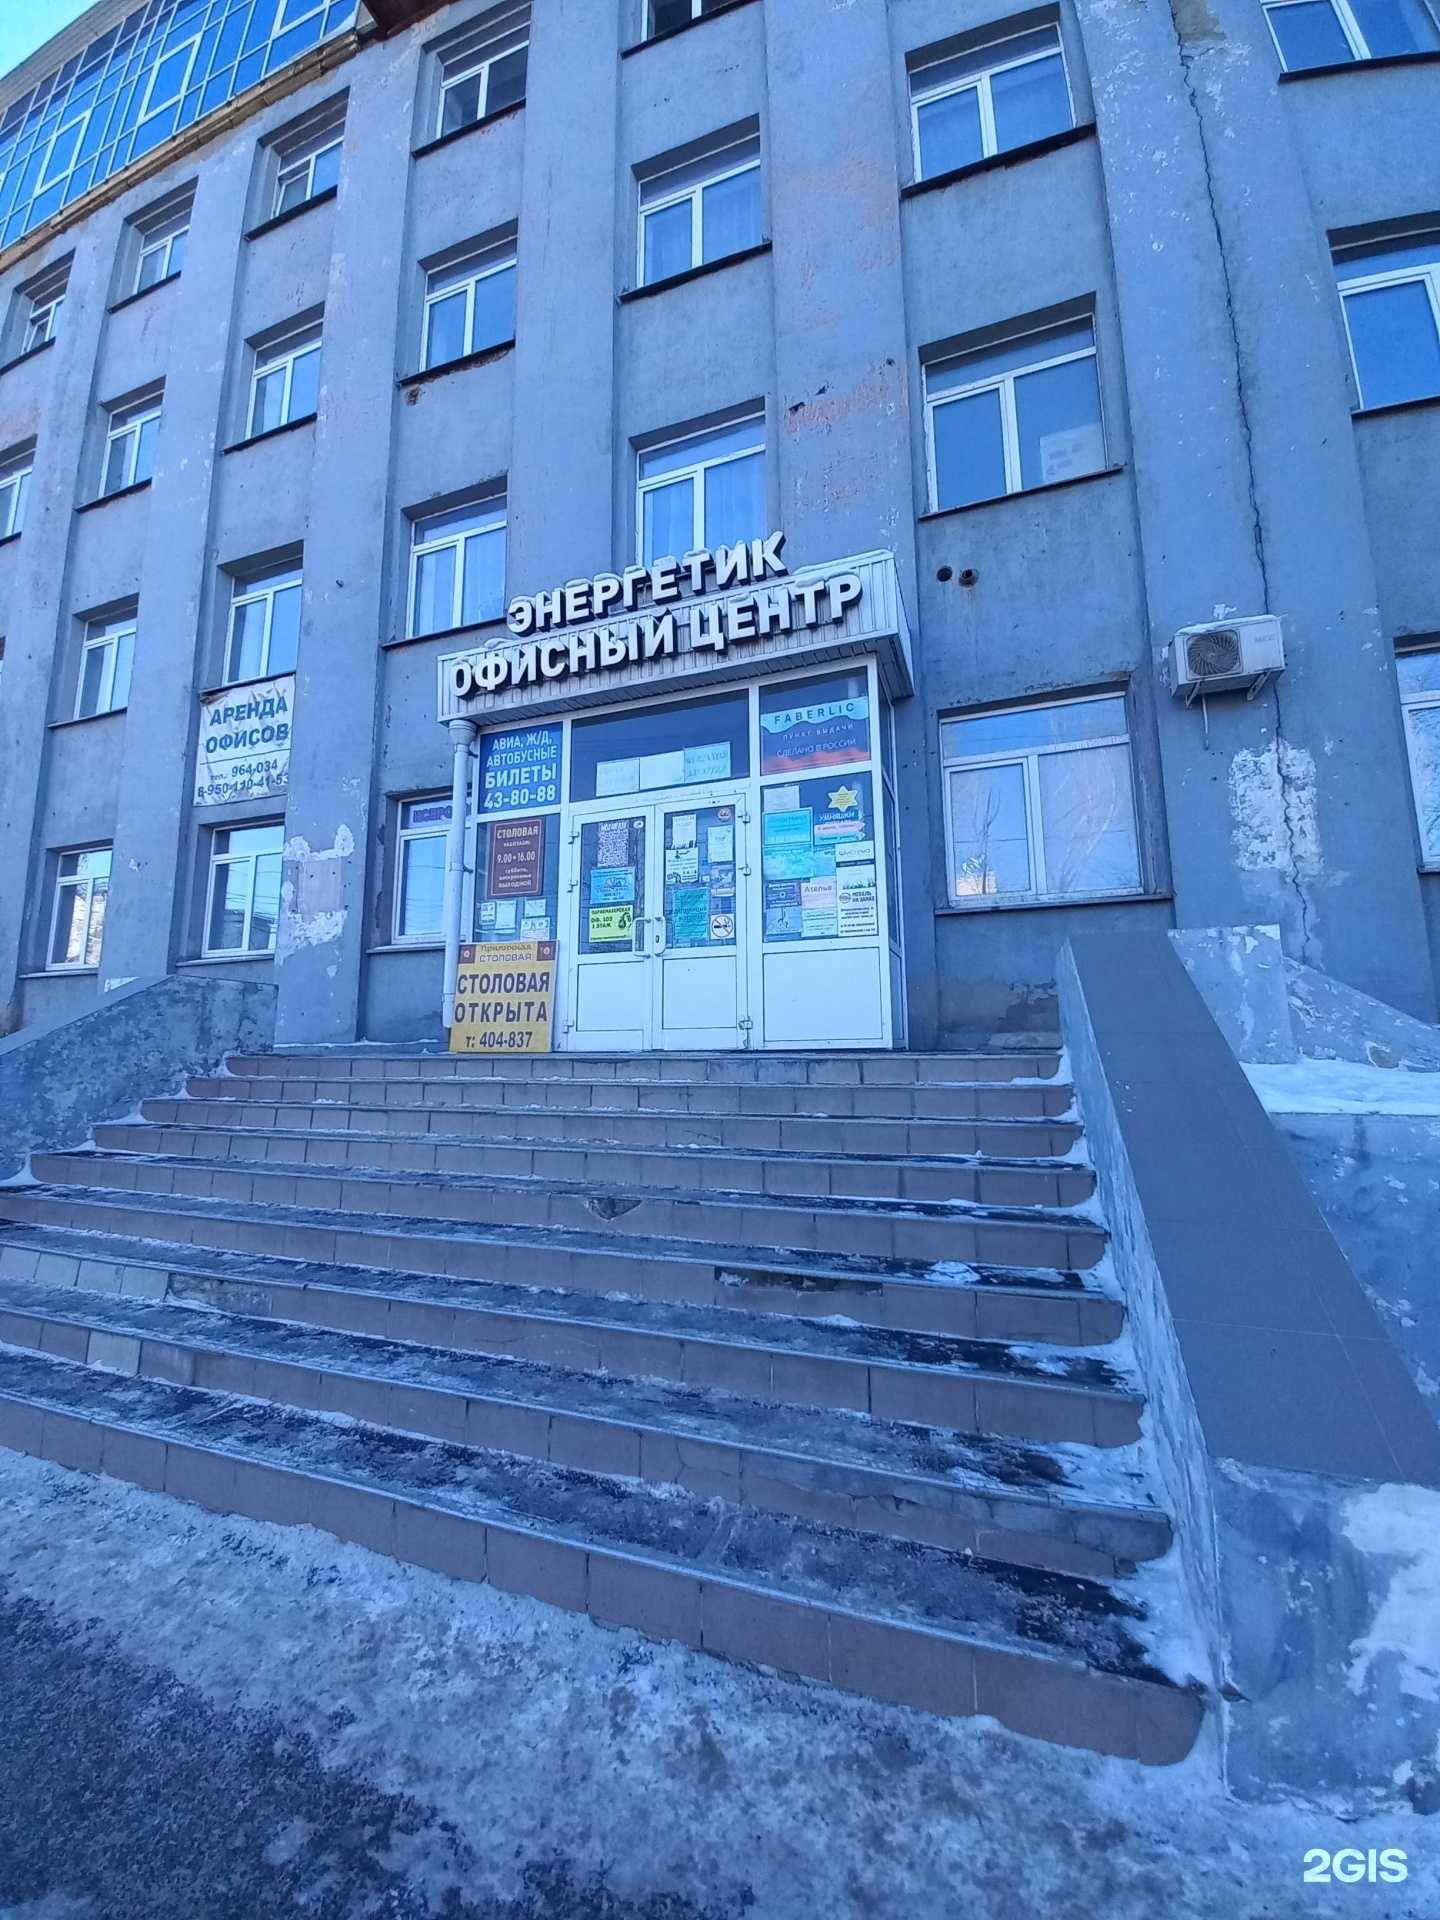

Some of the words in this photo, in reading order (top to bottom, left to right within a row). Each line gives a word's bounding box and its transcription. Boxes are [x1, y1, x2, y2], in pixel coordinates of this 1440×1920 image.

[507, 530, 788, 635] ЭНЕРГЕТИК
[450, 607, 683, 699] ОФИСНЫЙ
[690, 572, 864, 654] ЦЕНТР
[209, 695, 288, 726] АРЕНДА
[774, 702, 855, 724] FABERLIC
[206, 723, 290, 753] ОФИСОВ
[492, 735, 524, 751] АВИА,
[526, 730, 552, 746] Ж/Д,
[232, 758, 278, 777] 964-034
[486, 745, 557, 768] АВТОБУСНЫЕ
[485, 763, 557, 789] БИЛЕТЫ
[483, 784, 556, 809] 43-80-88
[497, 825, 539, 839] СТОЛОВАЯ
[479, 953, 532, 963] СТОЛОВАЯ
[457, 972, 550, 994] СТОЛОВАЯ
[454, 1001, 548, 1023] ОТКРЫТА
[465, 1036, 476, 1048] т:
[479, 1031, 533, 1048] 404-837
